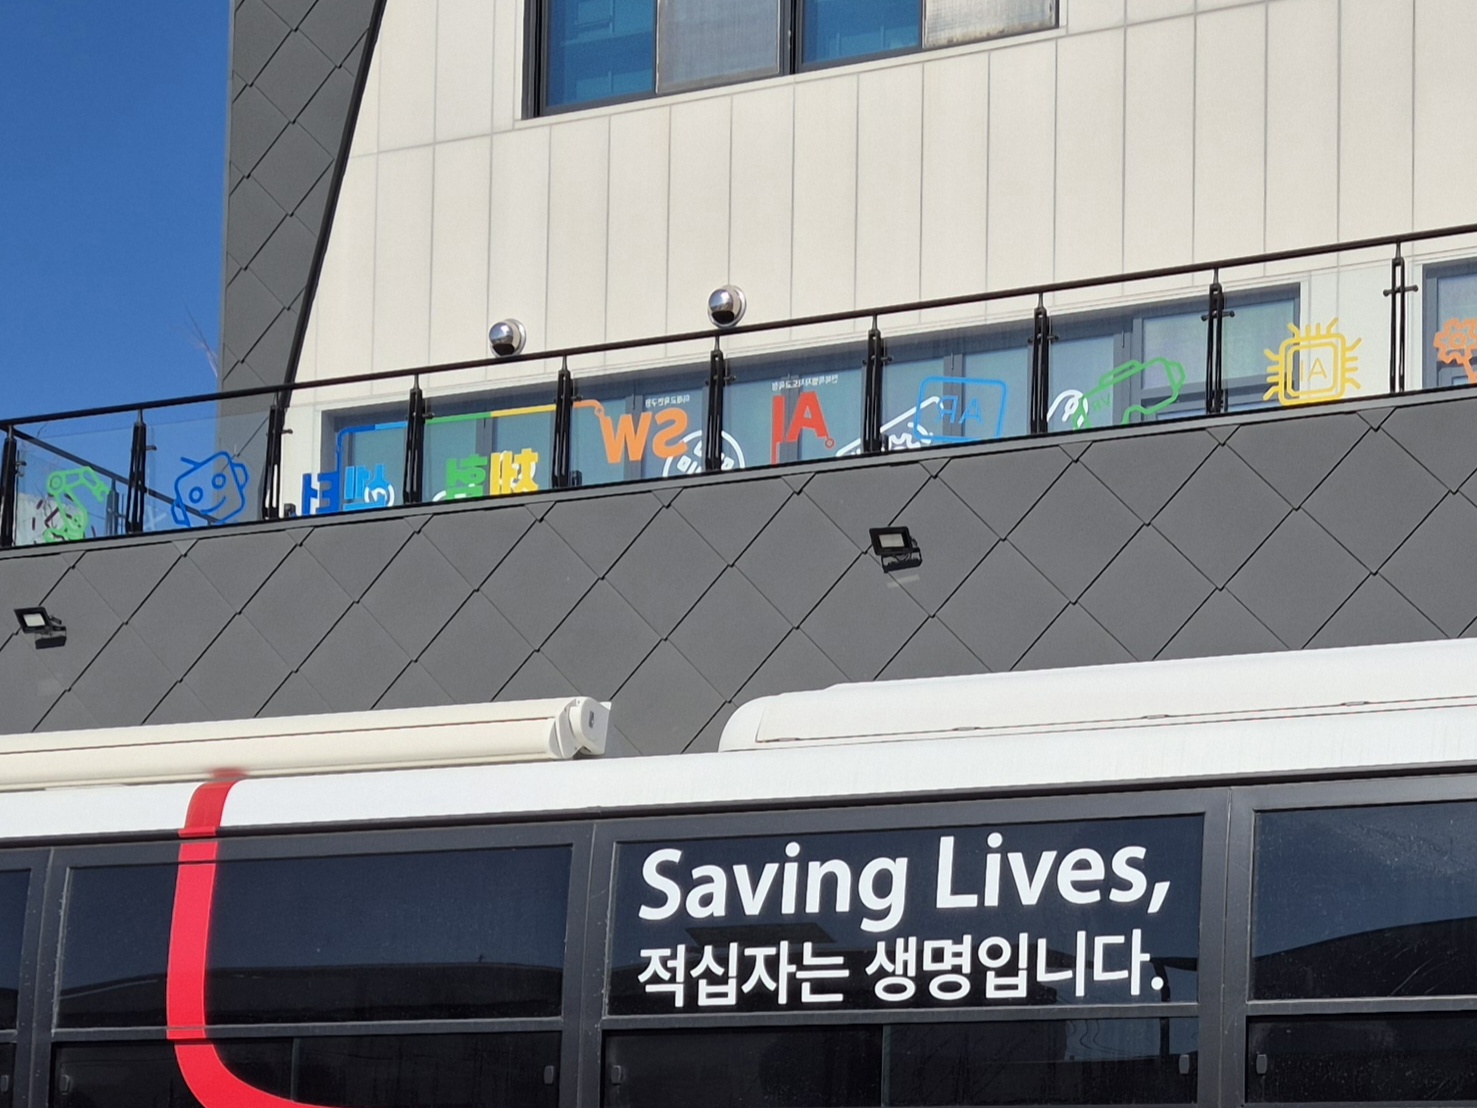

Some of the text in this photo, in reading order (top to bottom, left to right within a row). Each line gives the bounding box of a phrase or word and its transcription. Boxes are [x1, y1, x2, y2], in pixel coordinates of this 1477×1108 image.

[637, 831, 1172, 933] Saving Lives,
[637, 927, 1165, 1007] 적십자는 생명입니다.
